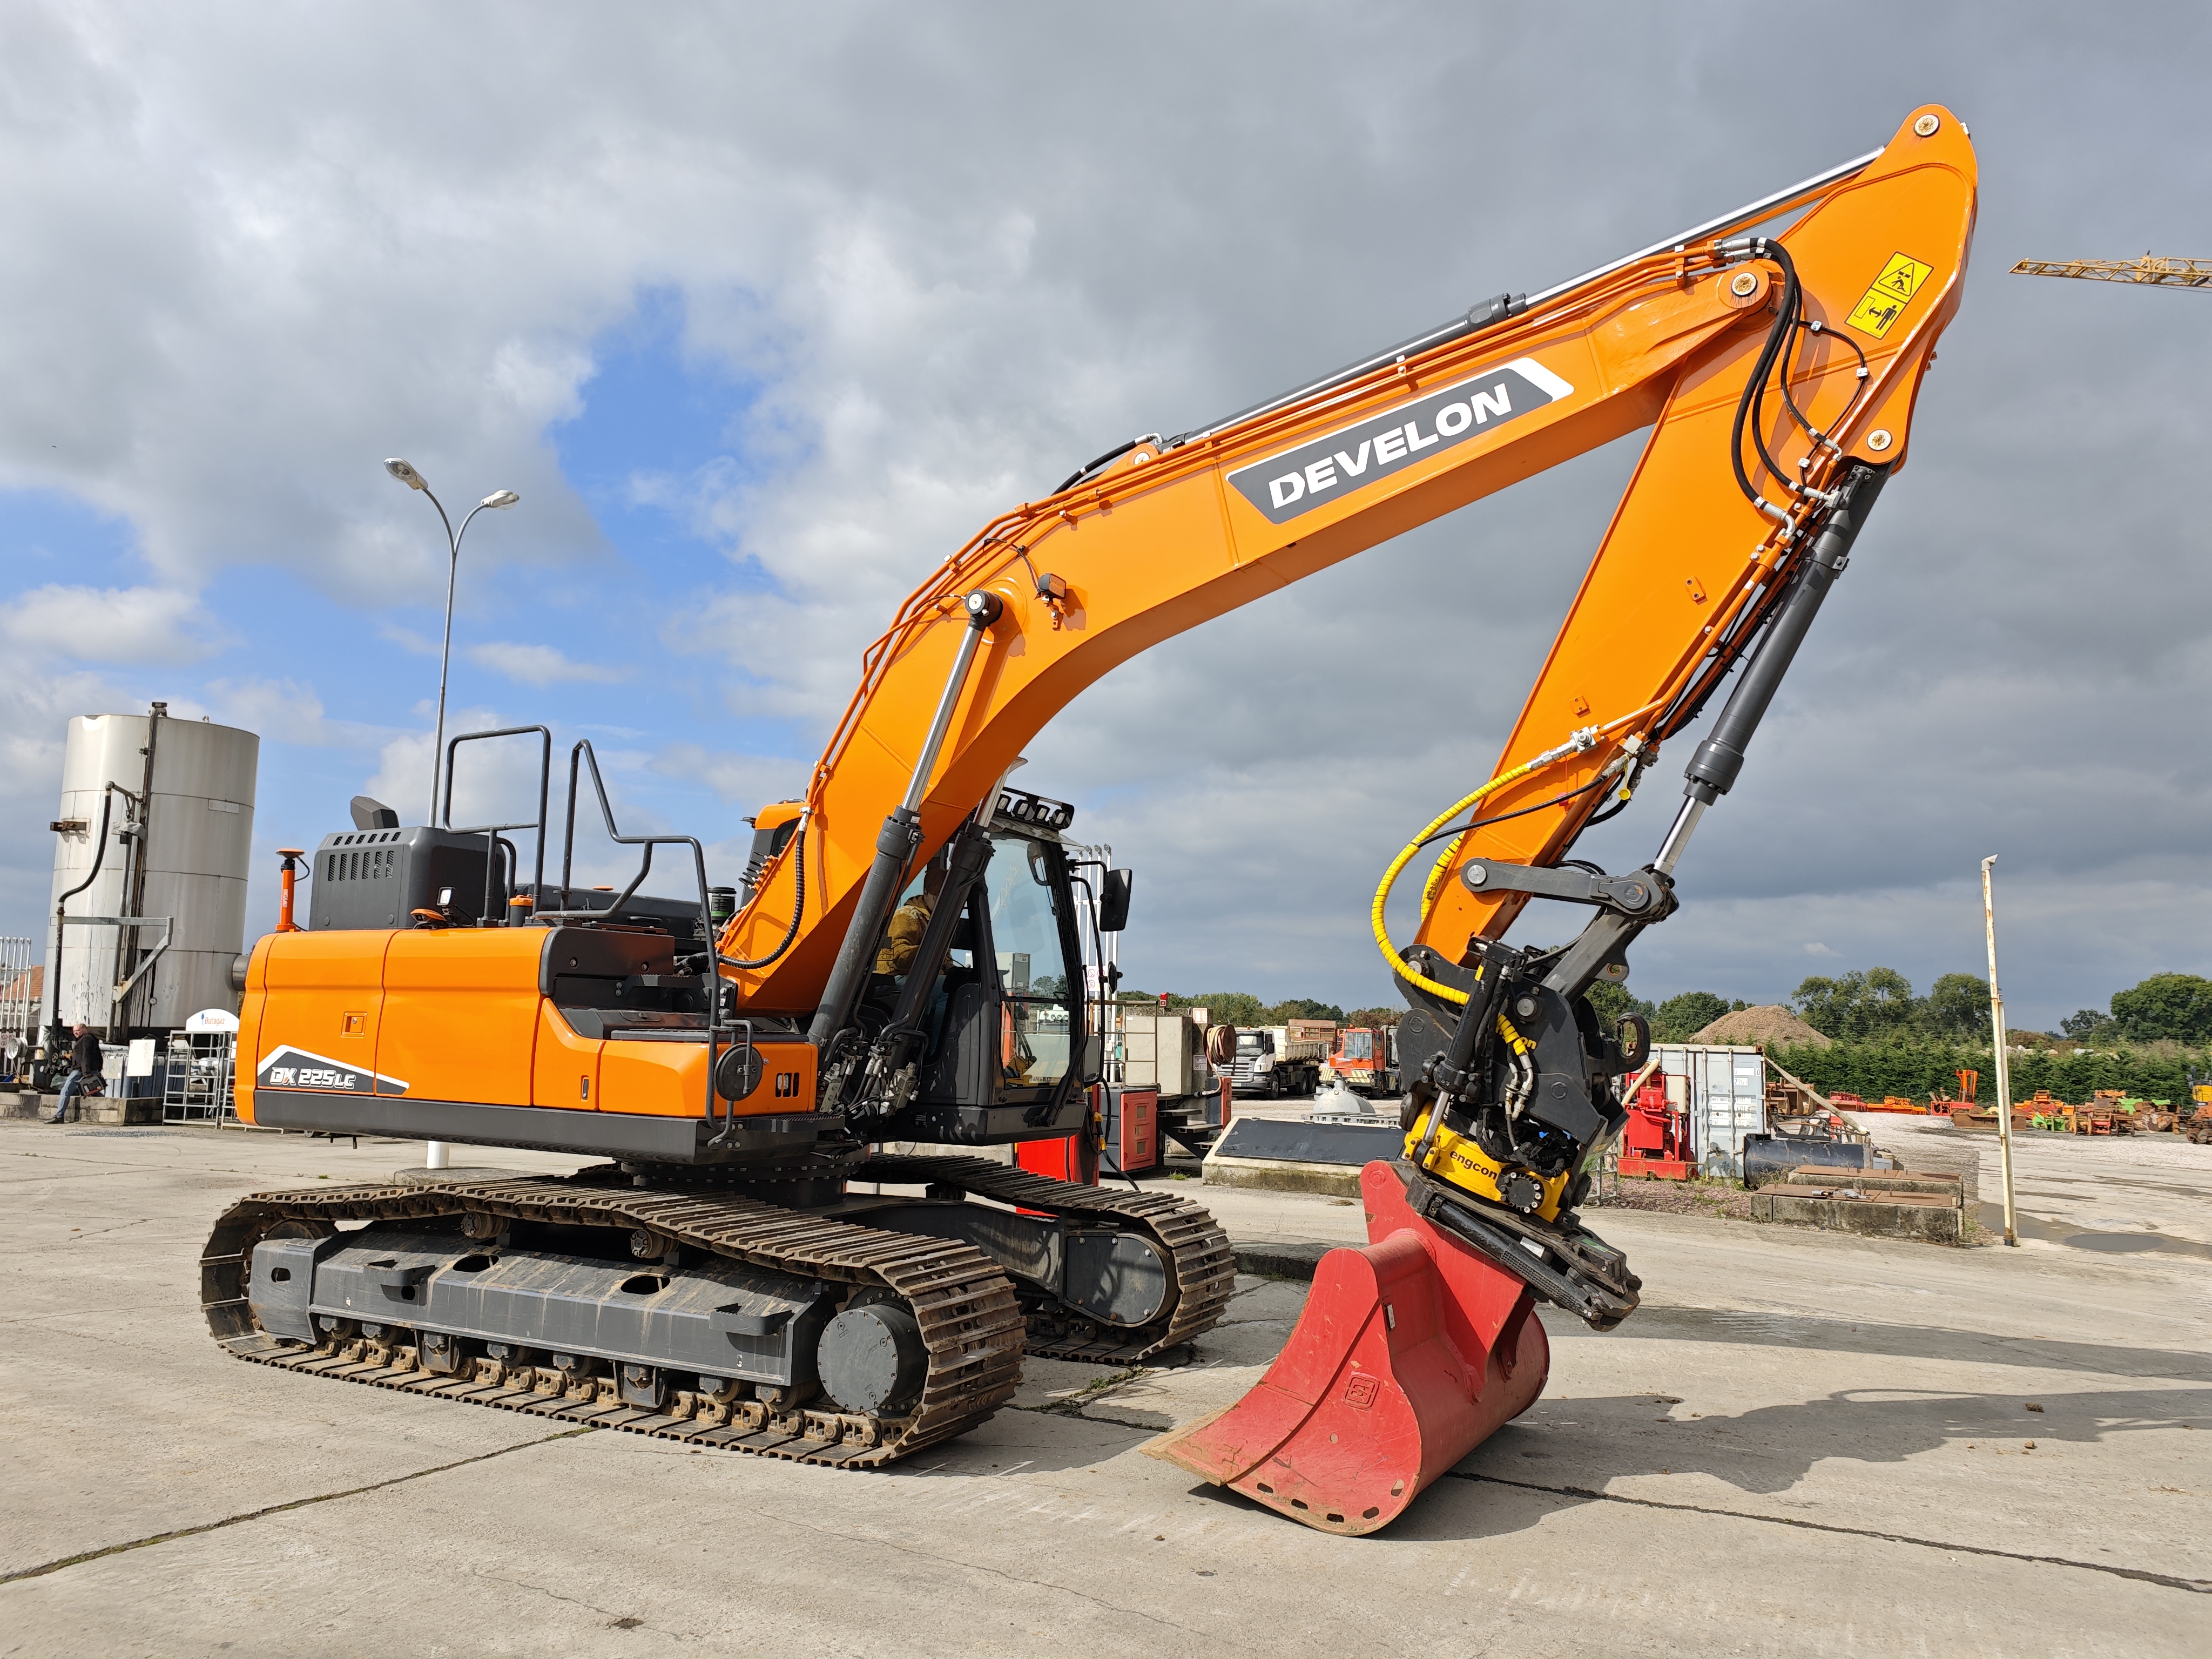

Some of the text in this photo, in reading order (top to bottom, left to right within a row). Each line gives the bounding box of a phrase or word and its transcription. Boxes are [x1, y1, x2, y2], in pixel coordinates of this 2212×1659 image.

[1269, 383, 1512, 509] DEVELON
[205, 1017, 225, 1026] Butagaz
[270, 1067, 297, 1085] DX
[1450, 1151, 1498, 1180] engcon
